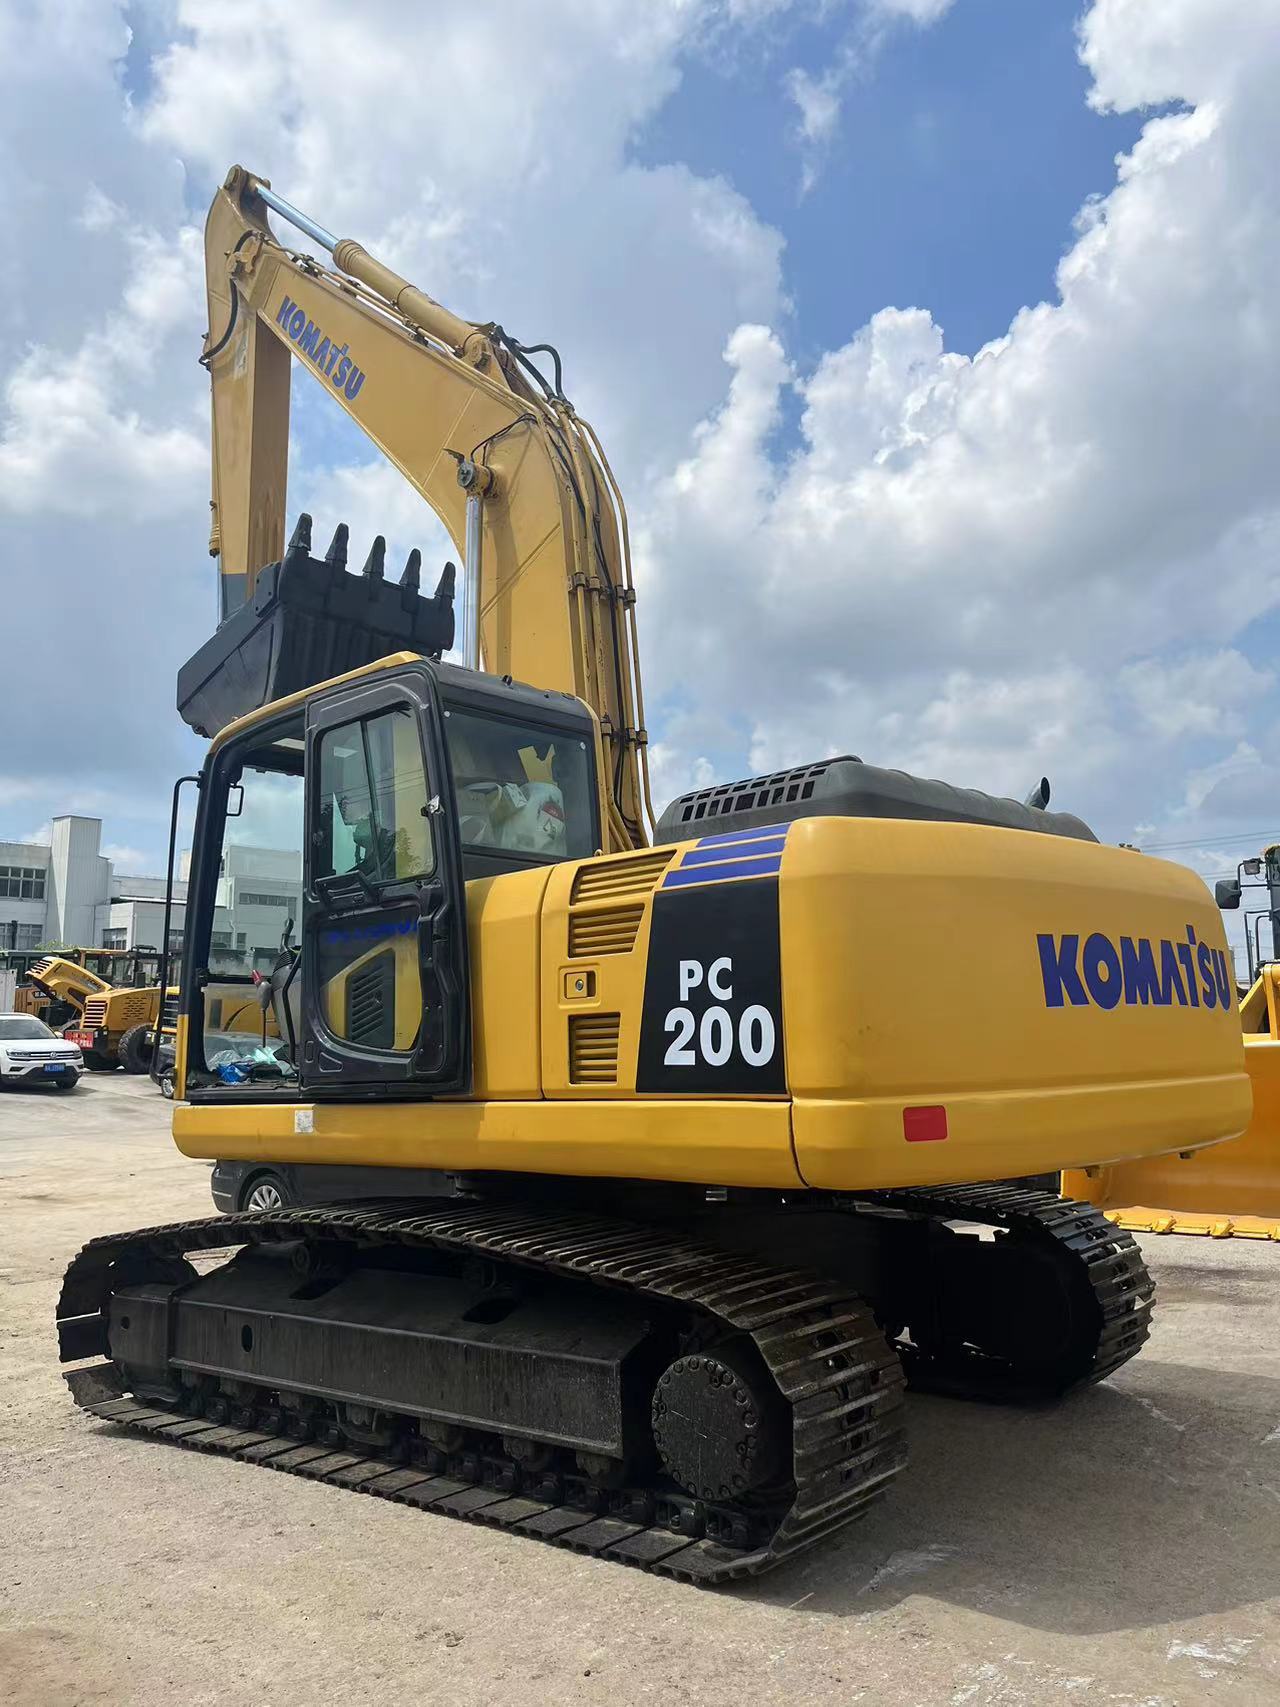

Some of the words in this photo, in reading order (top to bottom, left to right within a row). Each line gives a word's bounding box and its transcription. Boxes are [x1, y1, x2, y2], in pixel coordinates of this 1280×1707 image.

[276, 295, 366, 401] KOMATSU
[679, 957, 733, 1002] PC
[1036, 924, 1231, 1011] KOMATSU
[664, 1004, 776, 1067] 200
